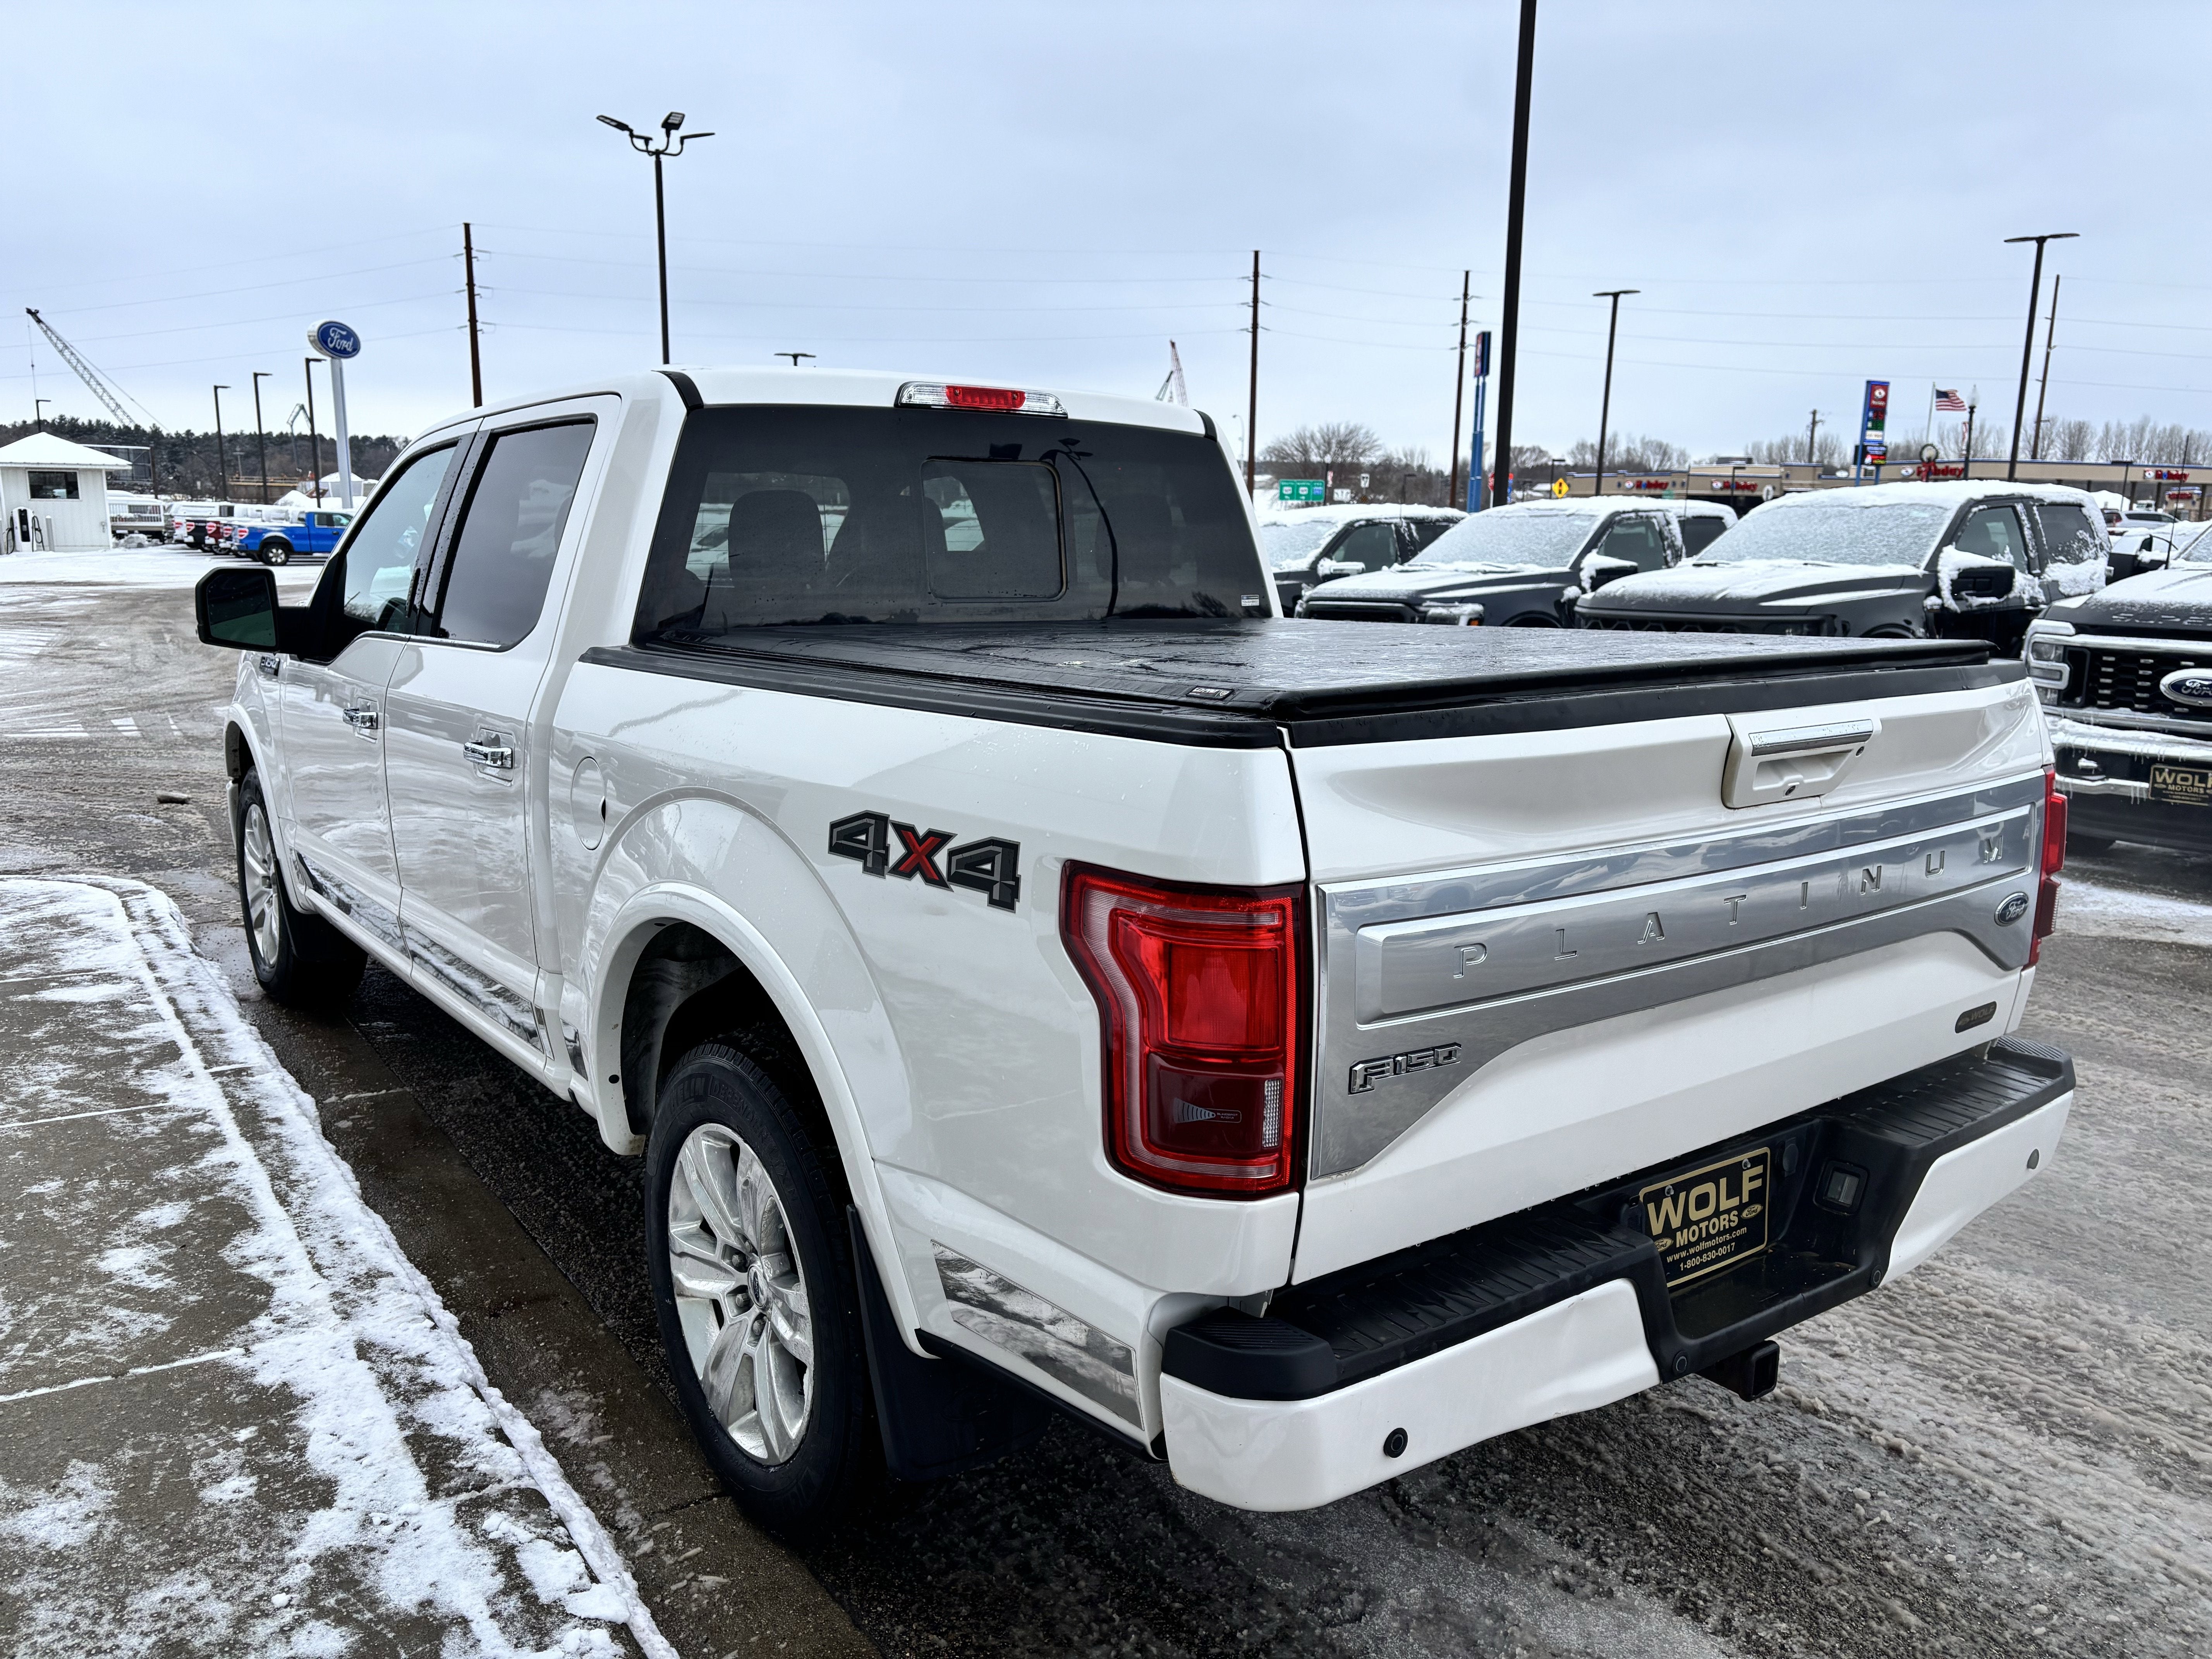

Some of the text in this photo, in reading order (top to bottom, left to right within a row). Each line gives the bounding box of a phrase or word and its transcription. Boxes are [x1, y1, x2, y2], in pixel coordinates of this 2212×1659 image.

[328, 327, 354, 352] Ford
[2168, 784, 2204, 793] MOTORS
[1453, 835, 2004, 979] PLATINUM
[2006, 900, 2025, 921] Ford
[1970, 1006, 1995, 1021] WOLF
[1647, 1164, 1764, 1236] WOLF
[1745, 1206, 1759, 1217] Ford
[1676, 1210, 1738, 1248] MOTORS
[1666, 1227, 1747, 1263] www.wolfmotors.com
[1680, 1242, 1735, 1271] 1-800-830-0017
